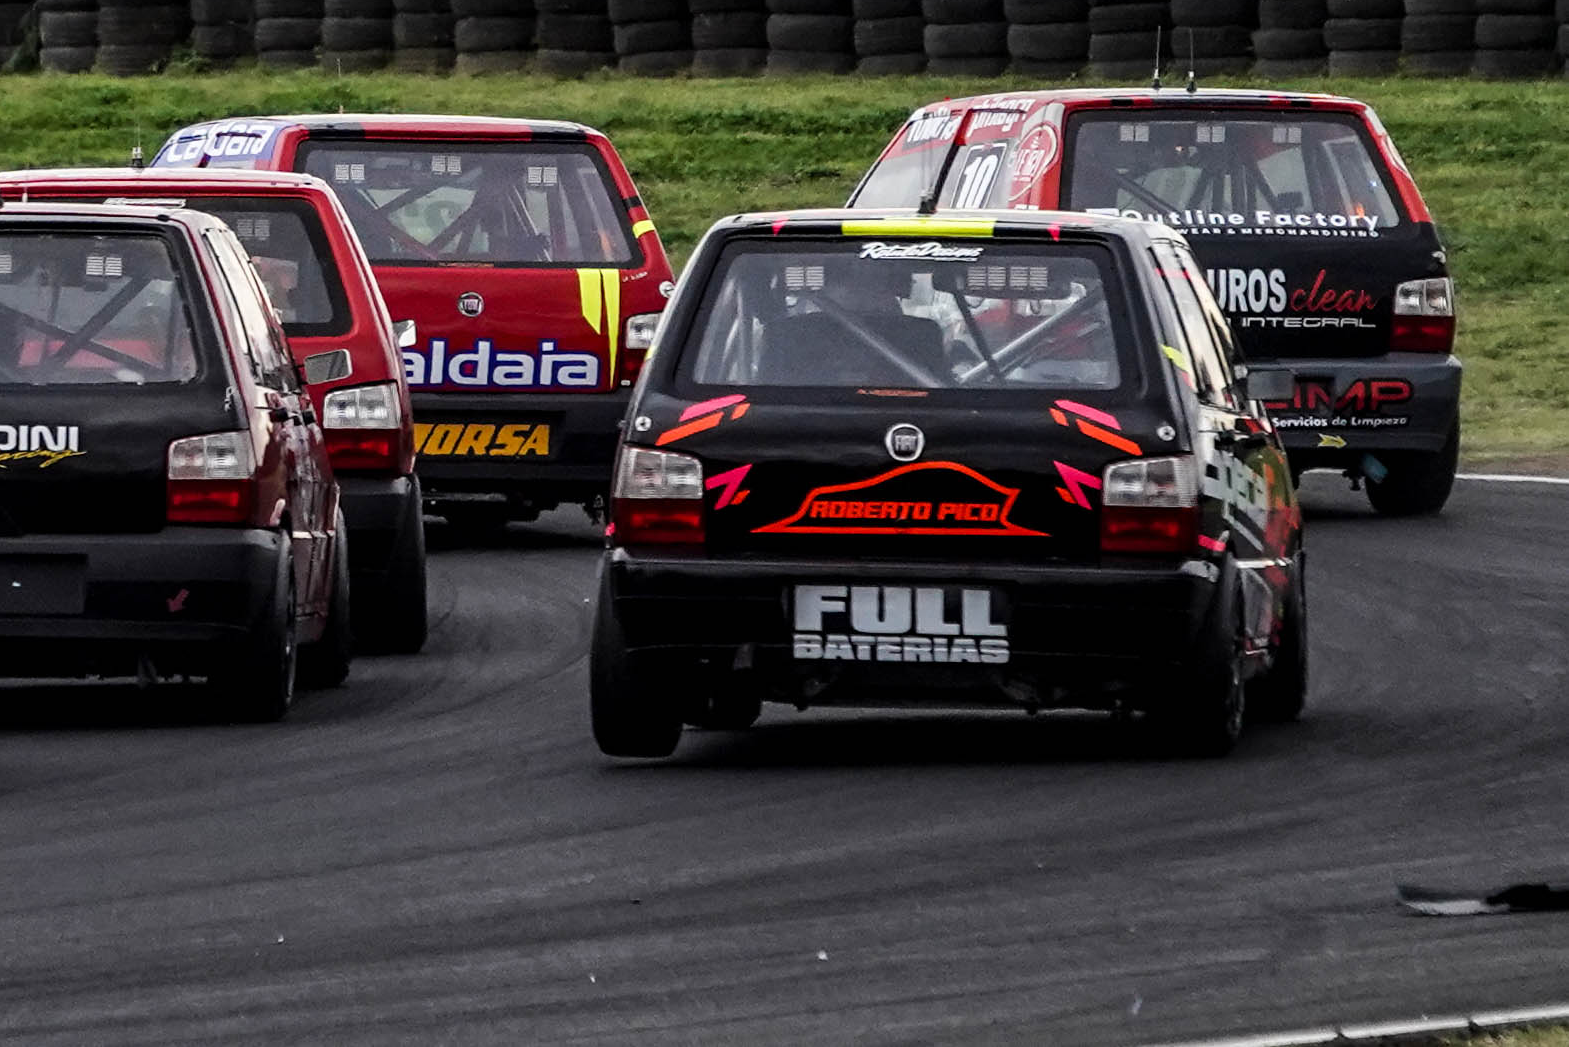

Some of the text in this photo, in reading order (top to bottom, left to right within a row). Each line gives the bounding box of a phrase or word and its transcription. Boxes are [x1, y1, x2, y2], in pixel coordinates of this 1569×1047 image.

[955, 154, 999, 209] 10
[1240, 227, 1379, 238] MERCHANDISING
[1255, 210, 1379, 231] Factory
[1206, 268, 1378, 313] UROS clean
[1241, 316, 1377, 328] INTEGRAL
[402, 340, 599, 386] aldaia
[1265, 380, 1411, 411] IMP
[1272, 416, 1328, 428] Servicios
[1331, 416, 1348, 427] de
[810, 500, 1000, 522] ROBERTO PICO
[794, 584, 1008, 637] FULL
[793, 634, 1011, 664] BATERIAS
